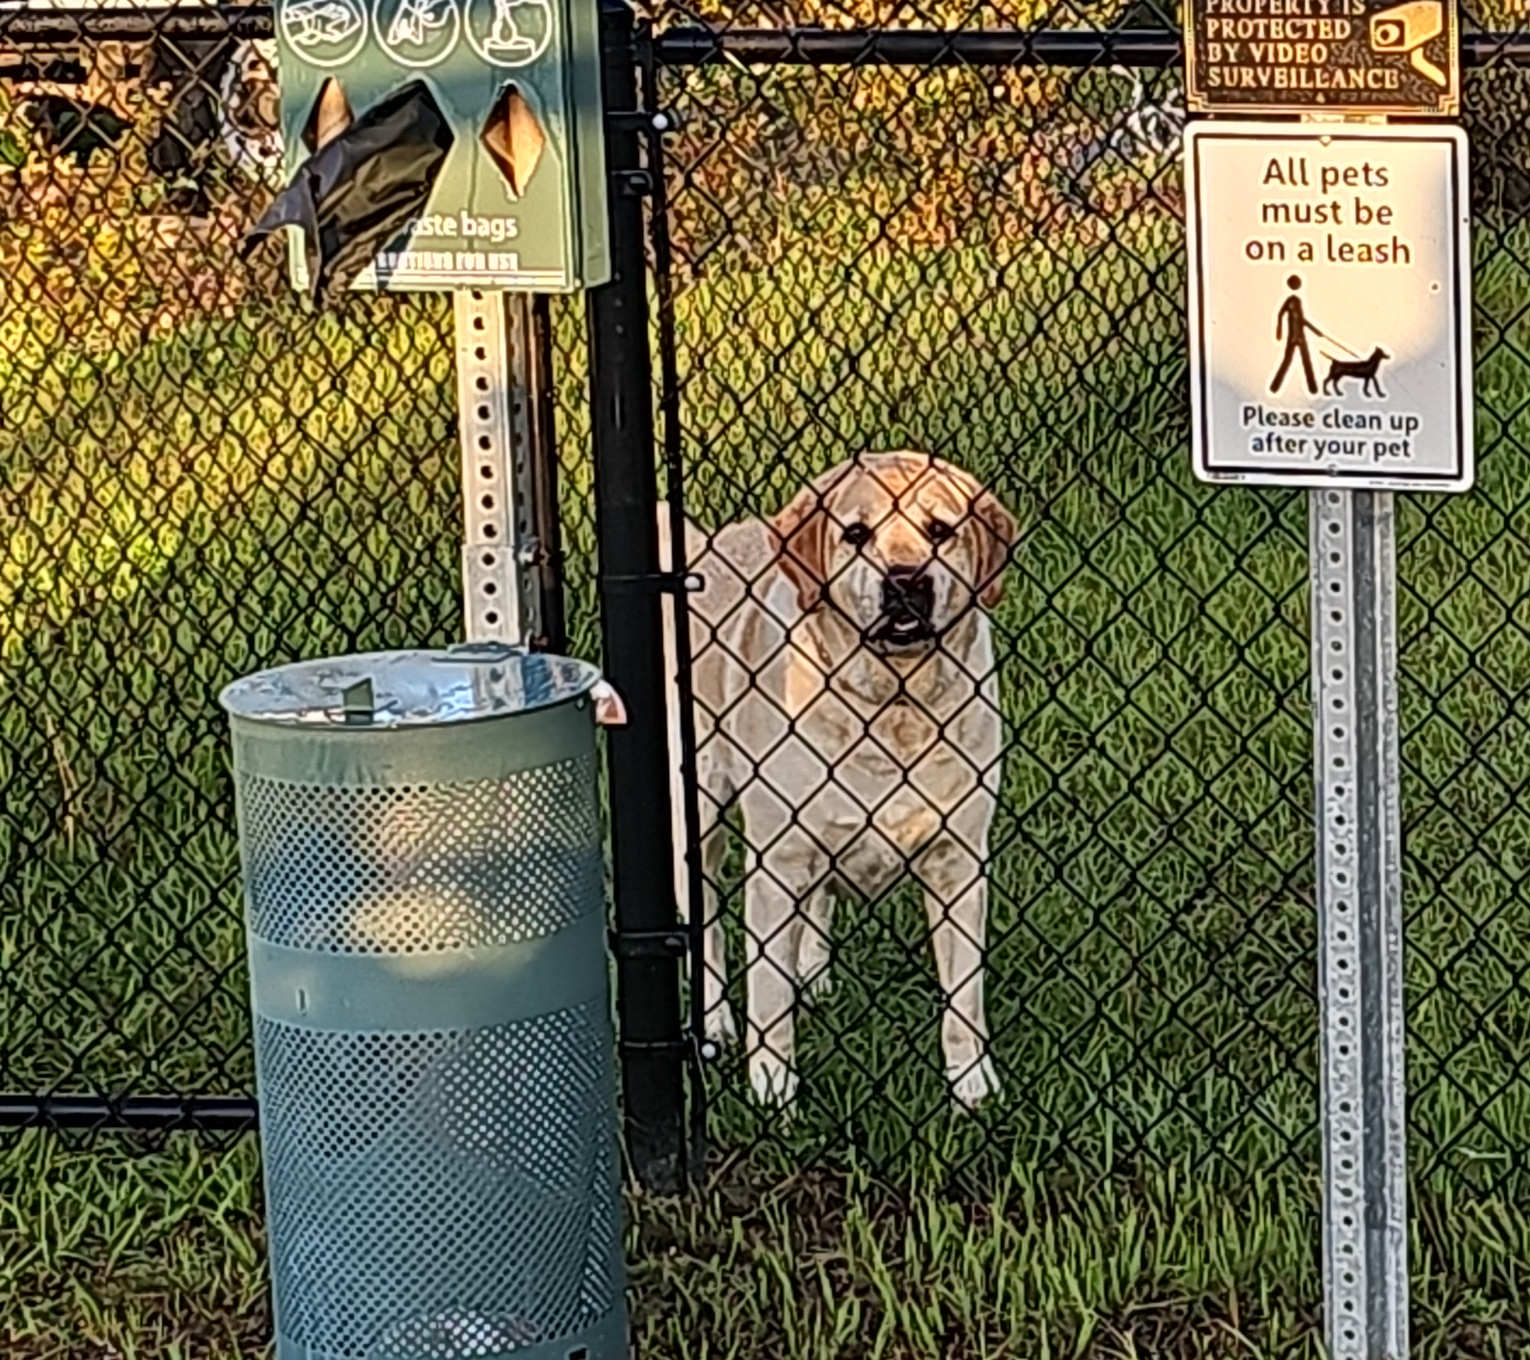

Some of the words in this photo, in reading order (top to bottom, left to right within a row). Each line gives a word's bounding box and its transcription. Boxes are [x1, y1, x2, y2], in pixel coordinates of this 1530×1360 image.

[1206, 18, 1350, 40] PROTECTED
[1207, 42, 1239, 63] BY
[1248, 43, 1328, 64] VIDEO
[1208, 66, 1400, 89] SURVEILLANCE
[1263, 157, 1309, 186] All
[1321, 162, 1389, 194] pets
[1262, 200, 1343, 225] must
[1355, 196, 1393, 225] be
[405, 215, 457, 238] aste
[462, 210, 518, 242] bags
[1245, 240, 1285, 261] on
[1297, 241, 1314, 262] a
[1327, 233, 1411, 264] leash
[1243, 406, 1315, 427] Please
[1322, 408, 1382, 430] clean
[1390, 414, 1419, 436] up
[1252, 432, 1307, 453] after
[1313, 440, 1367, 460] your
[1374, 440, 1411, 462] pet
